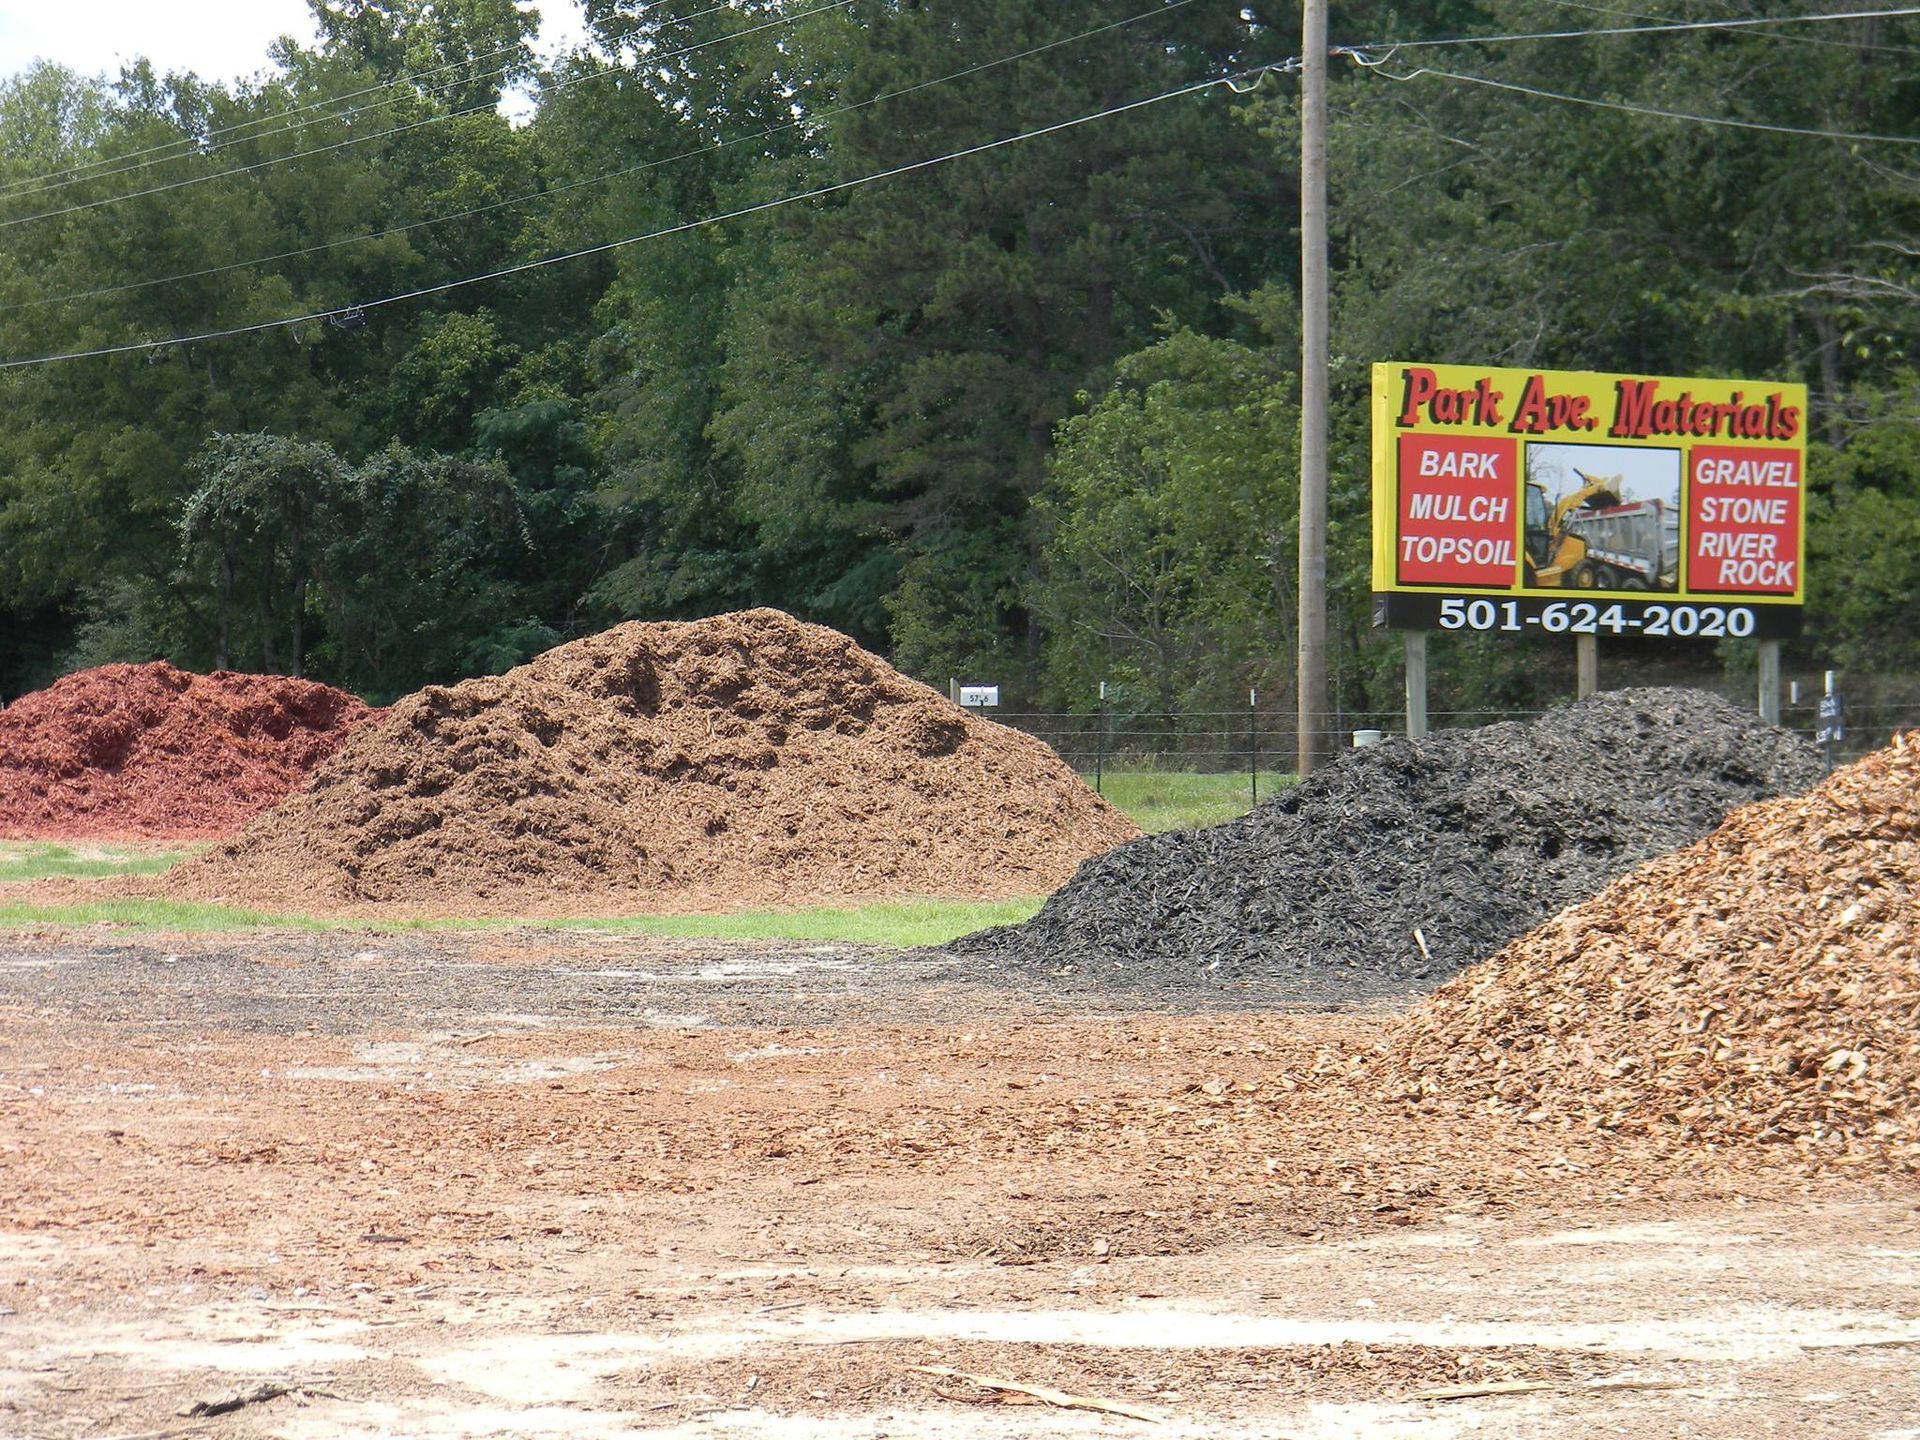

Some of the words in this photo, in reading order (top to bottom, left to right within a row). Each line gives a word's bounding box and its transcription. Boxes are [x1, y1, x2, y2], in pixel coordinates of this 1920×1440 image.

[1398, 368, 1503, 427] Park
[1511, 375, 1599, 433] Ave.
[1609, 380, 1800, 439] Materials
[1419, 450, 1500, 480] BARK
[1696, 458, 1798, 488] GRAVEL
[1409, 493, 1509, 523] MULCH
[1699, 496, 1788, 525] STONE
[1401, 535, 1517, 566] TOPSOIL
[1698, 531, 1777, 559] RIVER
[1718, 558, 1796, 587] ROCK
[1438, 599, 1755, 637] 501-624-2020
